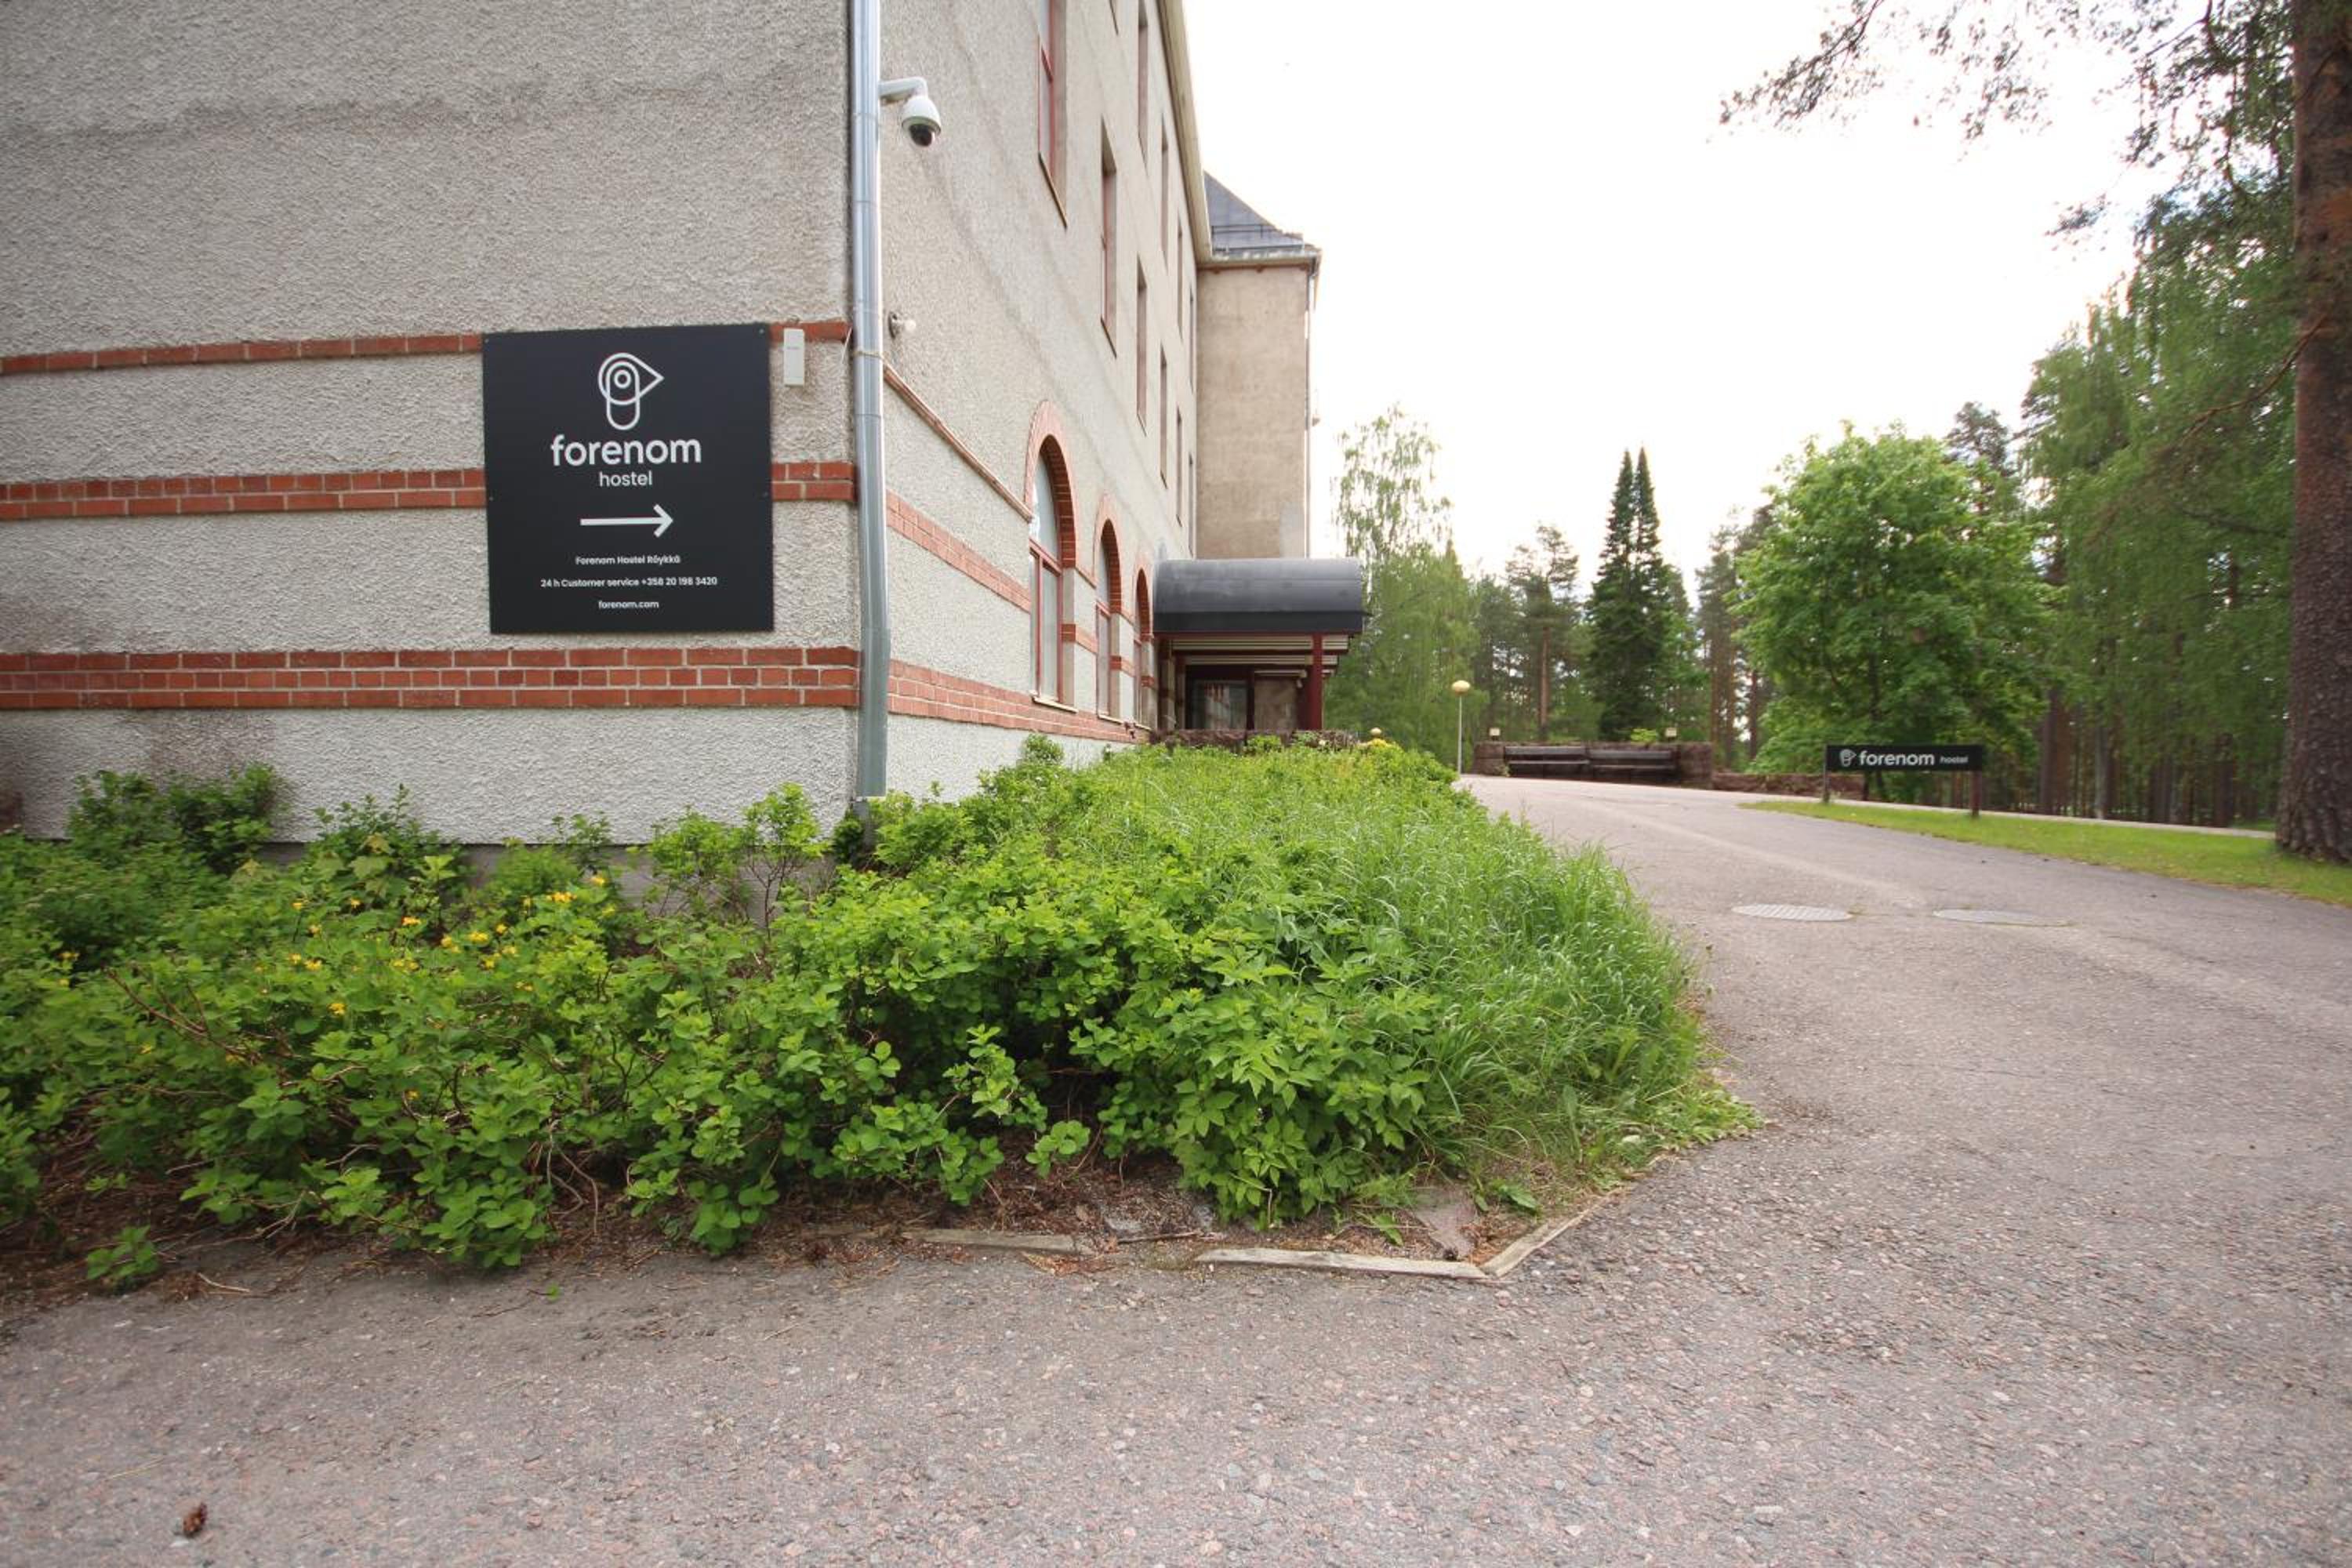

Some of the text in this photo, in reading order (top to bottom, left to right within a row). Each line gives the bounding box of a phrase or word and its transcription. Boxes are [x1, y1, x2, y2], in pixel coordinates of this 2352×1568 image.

[550, 434, 702, 466] forenom
[599, 470, 653, 487] hostel
[575, 556, 615, 565] Forenom
[616, 555, 646, 564] Hostel
[540, 576, 718, 588] 24 h Customer service +358 20 198 3420
[597, 599, 660, 610] forenom.com
[1859, 750, 1969, 766] forenom hostel
